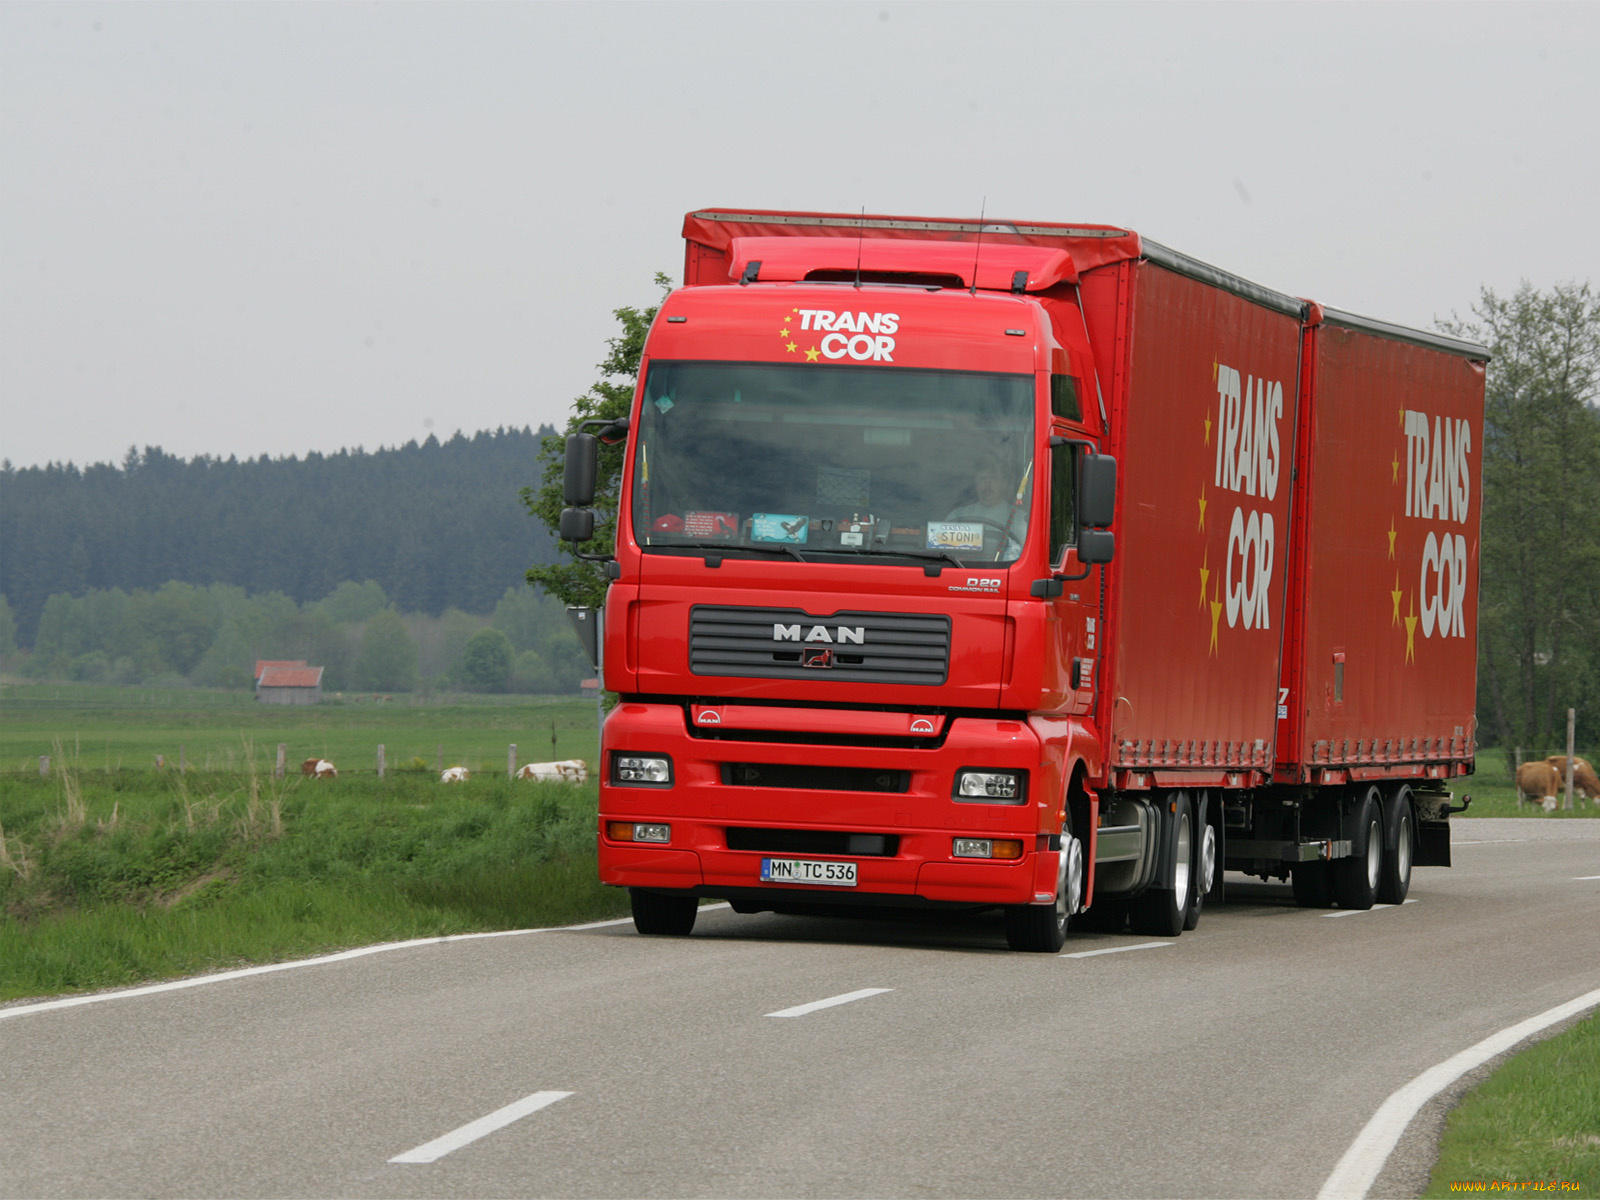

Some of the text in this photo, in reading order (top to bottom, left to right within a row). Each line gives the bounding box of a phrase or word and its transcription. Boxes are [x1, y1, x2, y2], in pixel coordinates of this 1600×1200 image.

[799, 309, 900, 334] TRANS
[821, 333, 896, 362] COR
[1215, 364, 1283, 501] TRANS
[1404, 410, 1471, 524] TRANS
[942, 532, 974, 542] STONI
[1225, 506, 1274, 630] COR
[1420, 531, 1467, 638] COR
[773, 624, 865, 644] MAN
[771, 862, 792, 876] MN
[803, 863, 822, 878] TC
[826, 865, 855, 880] 536
